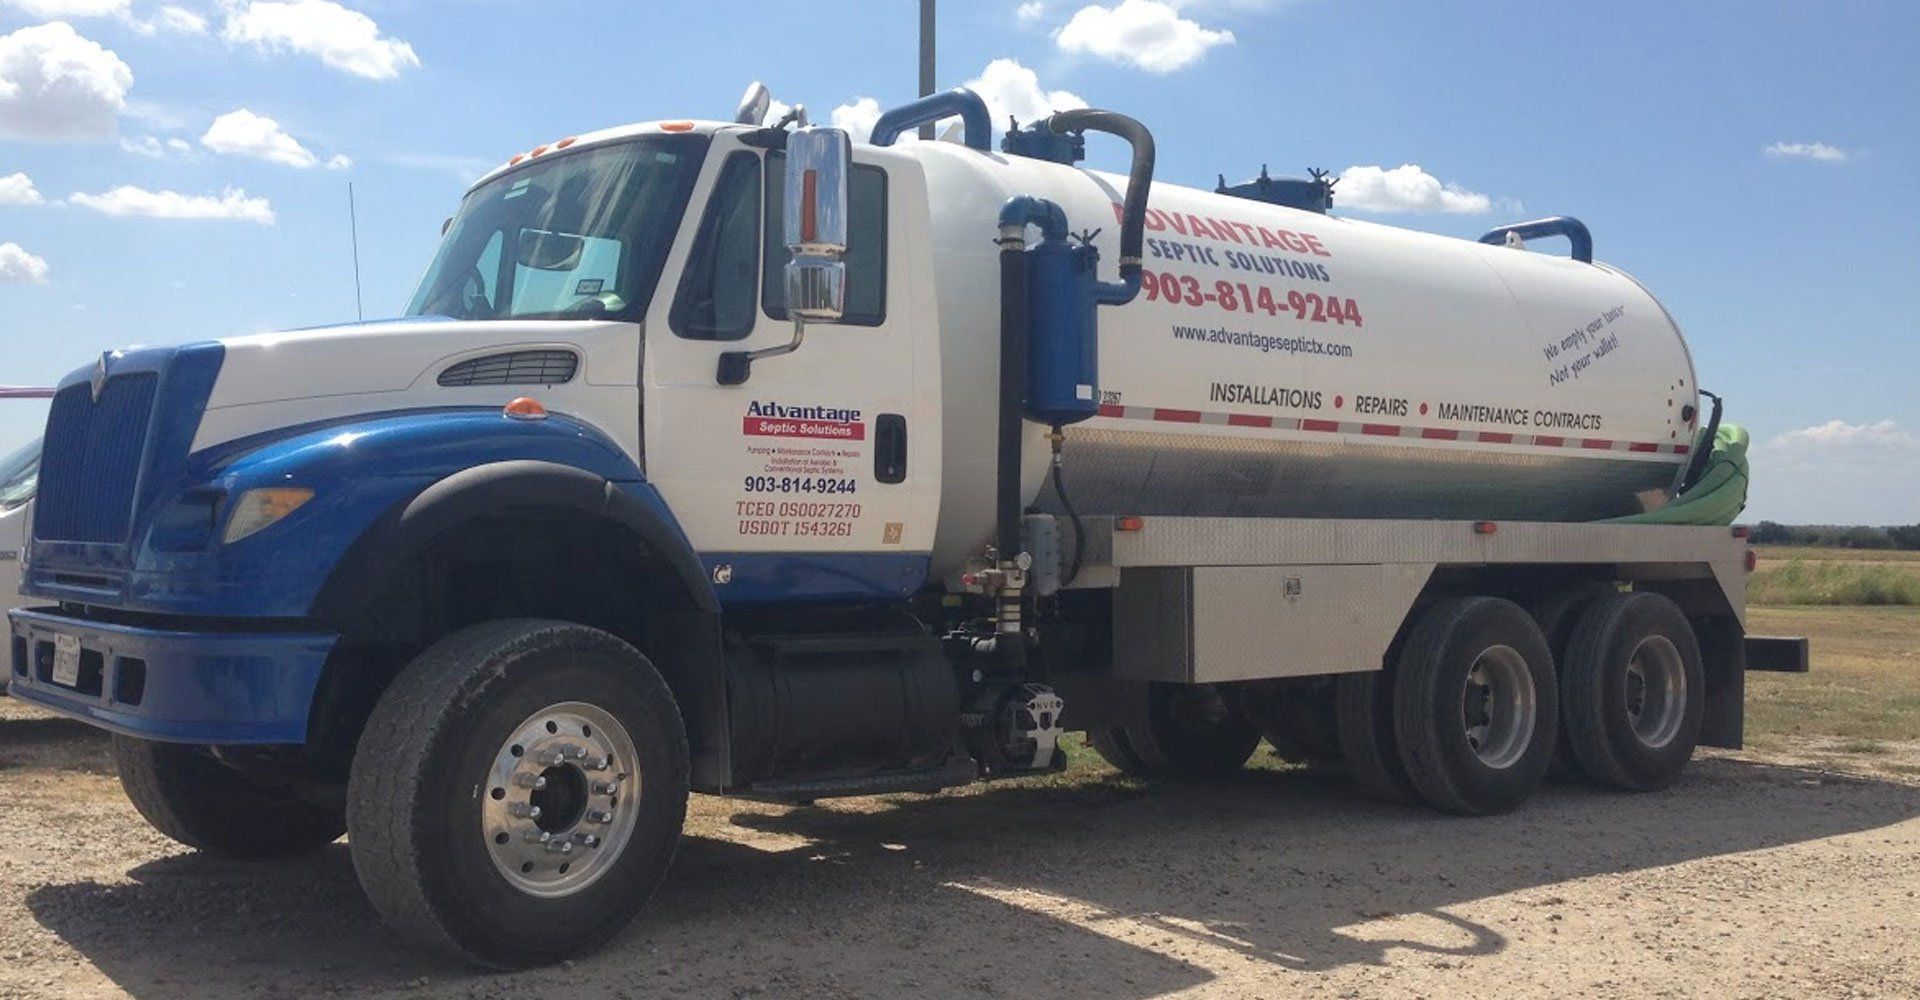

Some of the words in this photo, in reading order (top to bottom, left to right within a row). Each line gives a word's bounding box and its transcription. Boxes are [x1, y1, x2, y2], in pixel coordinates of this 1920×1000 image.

[1146, 238, 1220, 267] SEPTIC
[1225, 250, 1330, 282] SOLUTIONS
[1141, 269, 1363, 327] 903-814-9244
[1172, 325, 1353, 357] www.advantageseptictx.com
[1543, 343, 1559, 361] We
[1561, 328, 1587, 349] empty
[1586, 318, 1604, 340] your
[1550, 365, 1569, 386] Not
[1571, 354, 1591, 379] your
[747, 400, 861, 425] Advantage
[1210, 382, 1322, 410] INSTALLATIONS
[1355, 395, 1408, 417] REPAIRS
[1438, 403, 1529, 427] MAINTENANCE
[1533, 410, 1602, 430] CONTRACTS
[759, 421, 797, 434] Septic
[800, 423, 851, 436] Solutions
[745, 476, 856, 494] 903-814-9244
[739, 520, 790, 535] USDOT
[793, 522, 852, 536] 1543261
